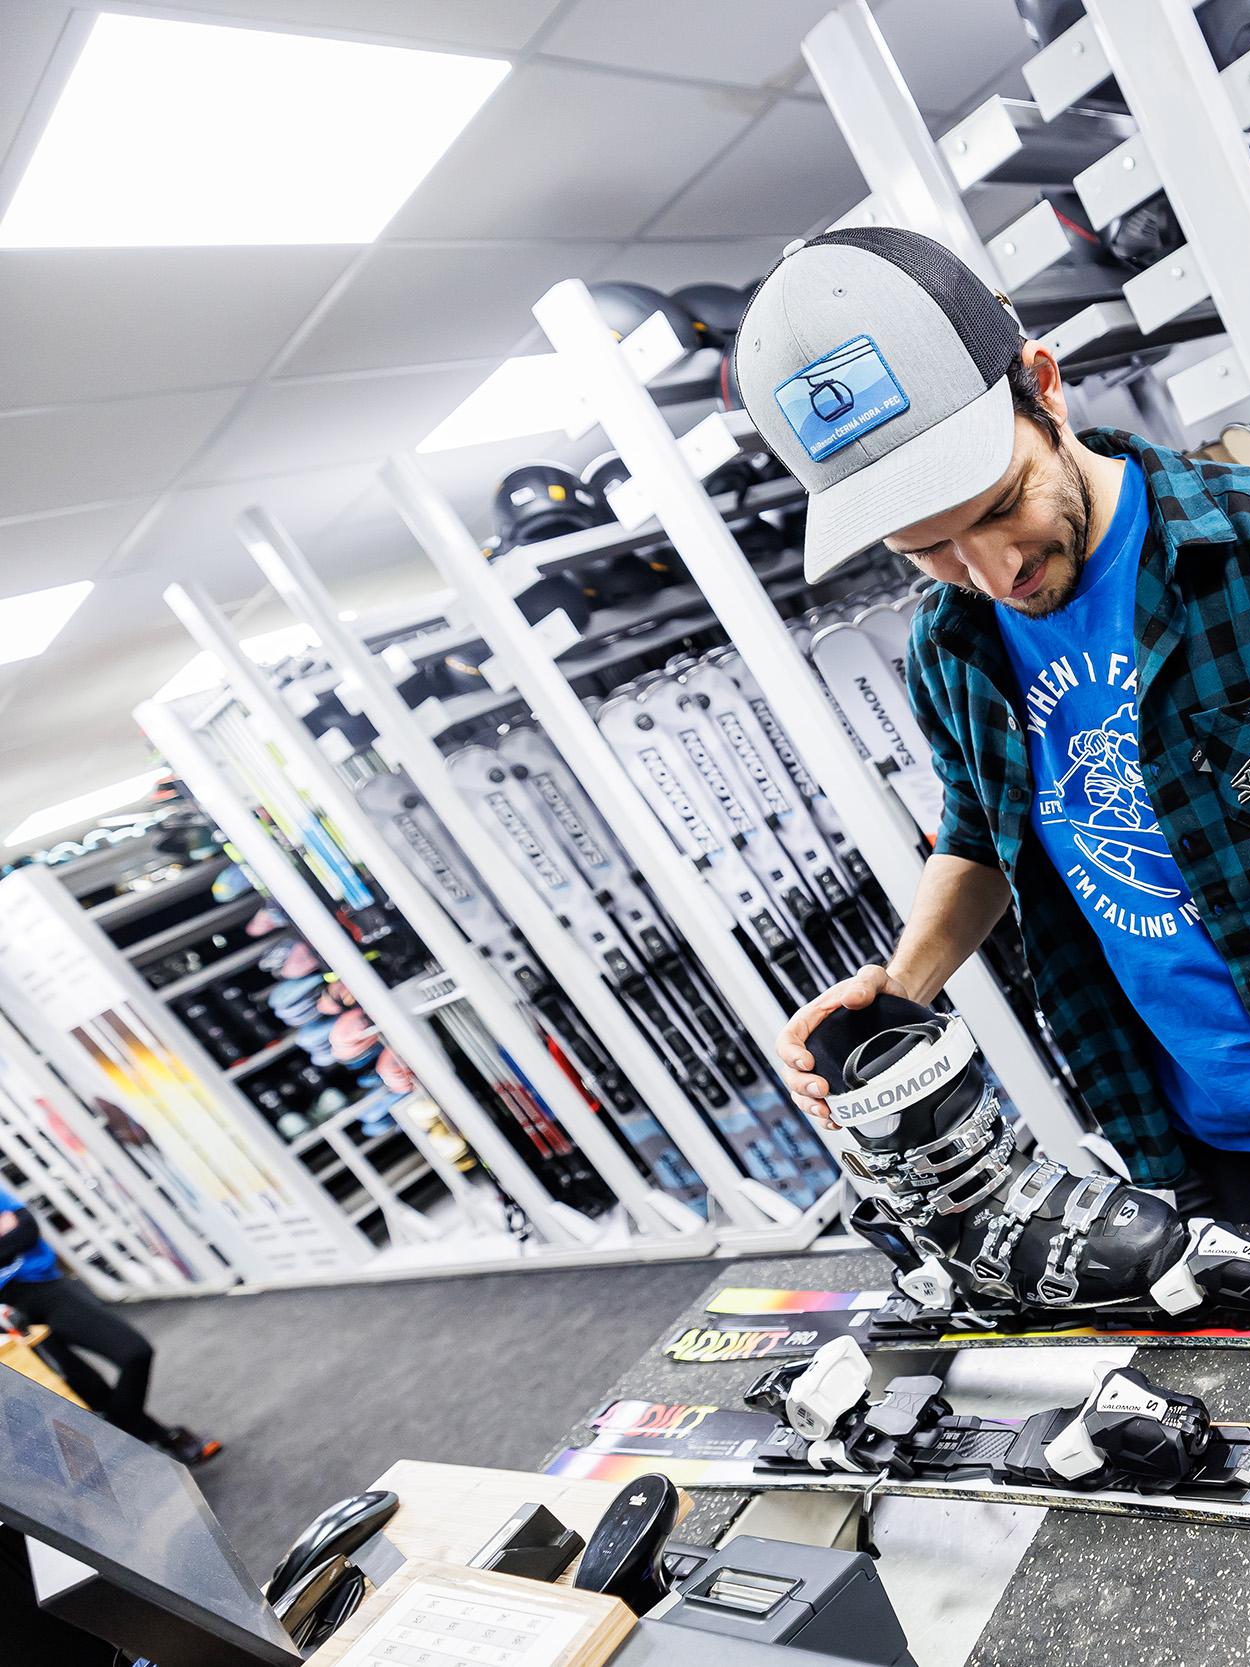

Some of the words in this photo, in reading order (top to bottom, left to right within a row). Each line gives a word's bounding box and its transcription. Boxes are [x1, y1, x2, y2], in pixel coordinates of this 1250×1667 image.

[835, 418, 860, 438] ČERNÁ
[858, 407, 881, 425] HORA
[883, 395, 901, 409] PEC
[1027, 655, 1079, 738] WHEN
[1083, 651, 1097, 683] I
[1107, 652, 1138, 695] FA
[854, 676, 916, 767] SALOMON
[1040, 800, 1063, 816] LET'S
[1066, 864, 1098, 900] I'M
[1094, 894, 1178, 938] FALLING
[837, 1056, 951, 1119] SALOMON
[784, 1331, 818, 1346] PRO
[1101, 1403, 1142, 1412] SALOMON
